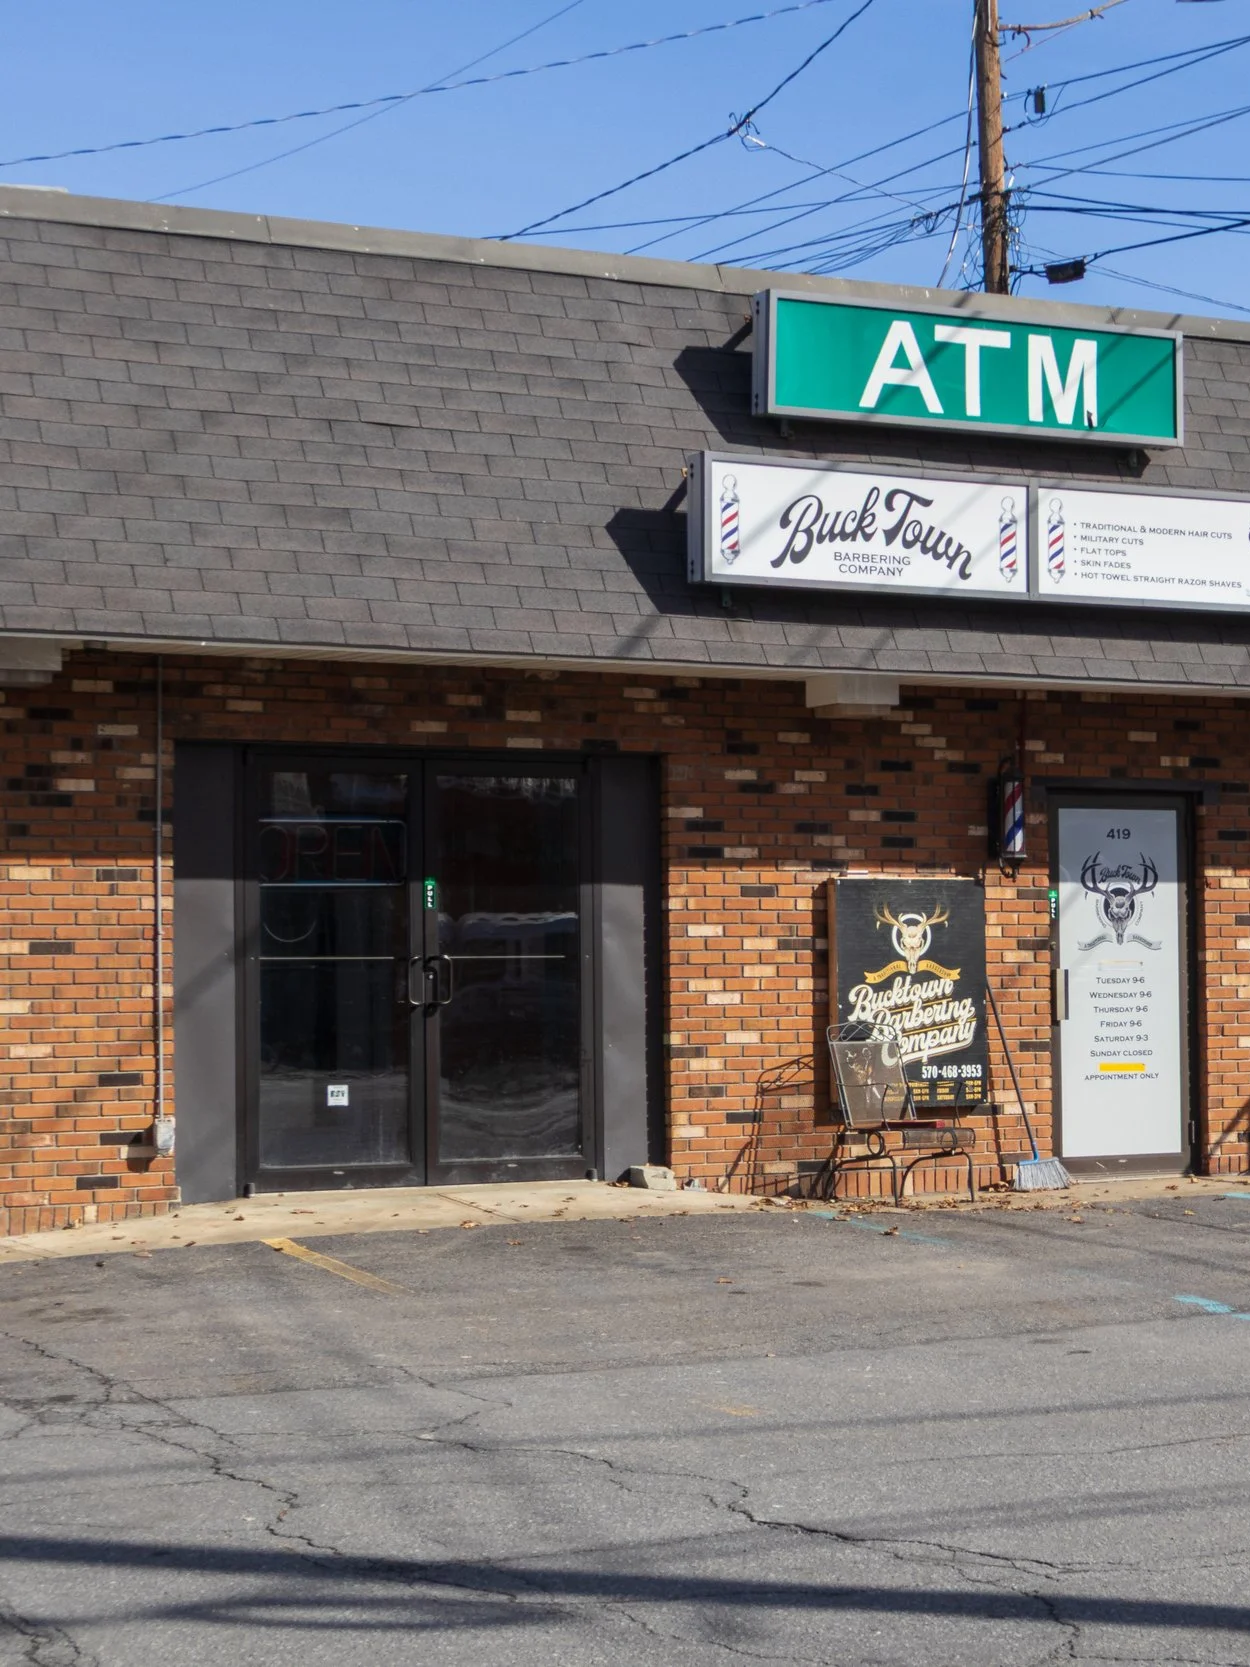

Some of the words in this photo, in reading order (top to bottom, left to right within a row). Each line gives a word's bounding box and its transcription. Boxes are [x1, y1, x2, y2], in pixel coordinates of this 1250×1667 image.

[858, 319, 1098, 428] ATM
[770, 486, 880, 569] Buck
[882, 488, 972, 581] Town
[1081, 522, 1137, 533] TRADITIONAL
[1149, 528, 1186, 537] MODERN
[1080, 535, 1119, 544] MILITARY
[1121, 537, 1144, 545] CUTS
[1080, 547, 1102, 556] FLAT
[1105, 549, 1127, 557] TOPS
[833, 551, 911, 566] BARBERING
[838, 564, 904, 576] COMPANY
[1080, 560, 1101, 568] SKIN
[1103, 561, 1132, 570] FADES
[1081, 572, 1099, 580] HOT
[1101, 573, 1131, 582] TOWEL
[1133, 576, 1176, 585] STRAIGHT
[1178, 578, 1207, 586] RAZOR
[1209, 580, 1242, 588] SHAVES
[1106, 828, 1131, 840] 419
[1098, 864, 1121, 884] Buck
[1121, 864, 1141, 884] Town
[1132, 976, 1145, 984] 9-6
[847, 975, 954, 1022] Bucktown
[1122, 1049, 1153, 1057] CLOSED
[1084, 1073, 1138, 1081] APPOINTMENT
